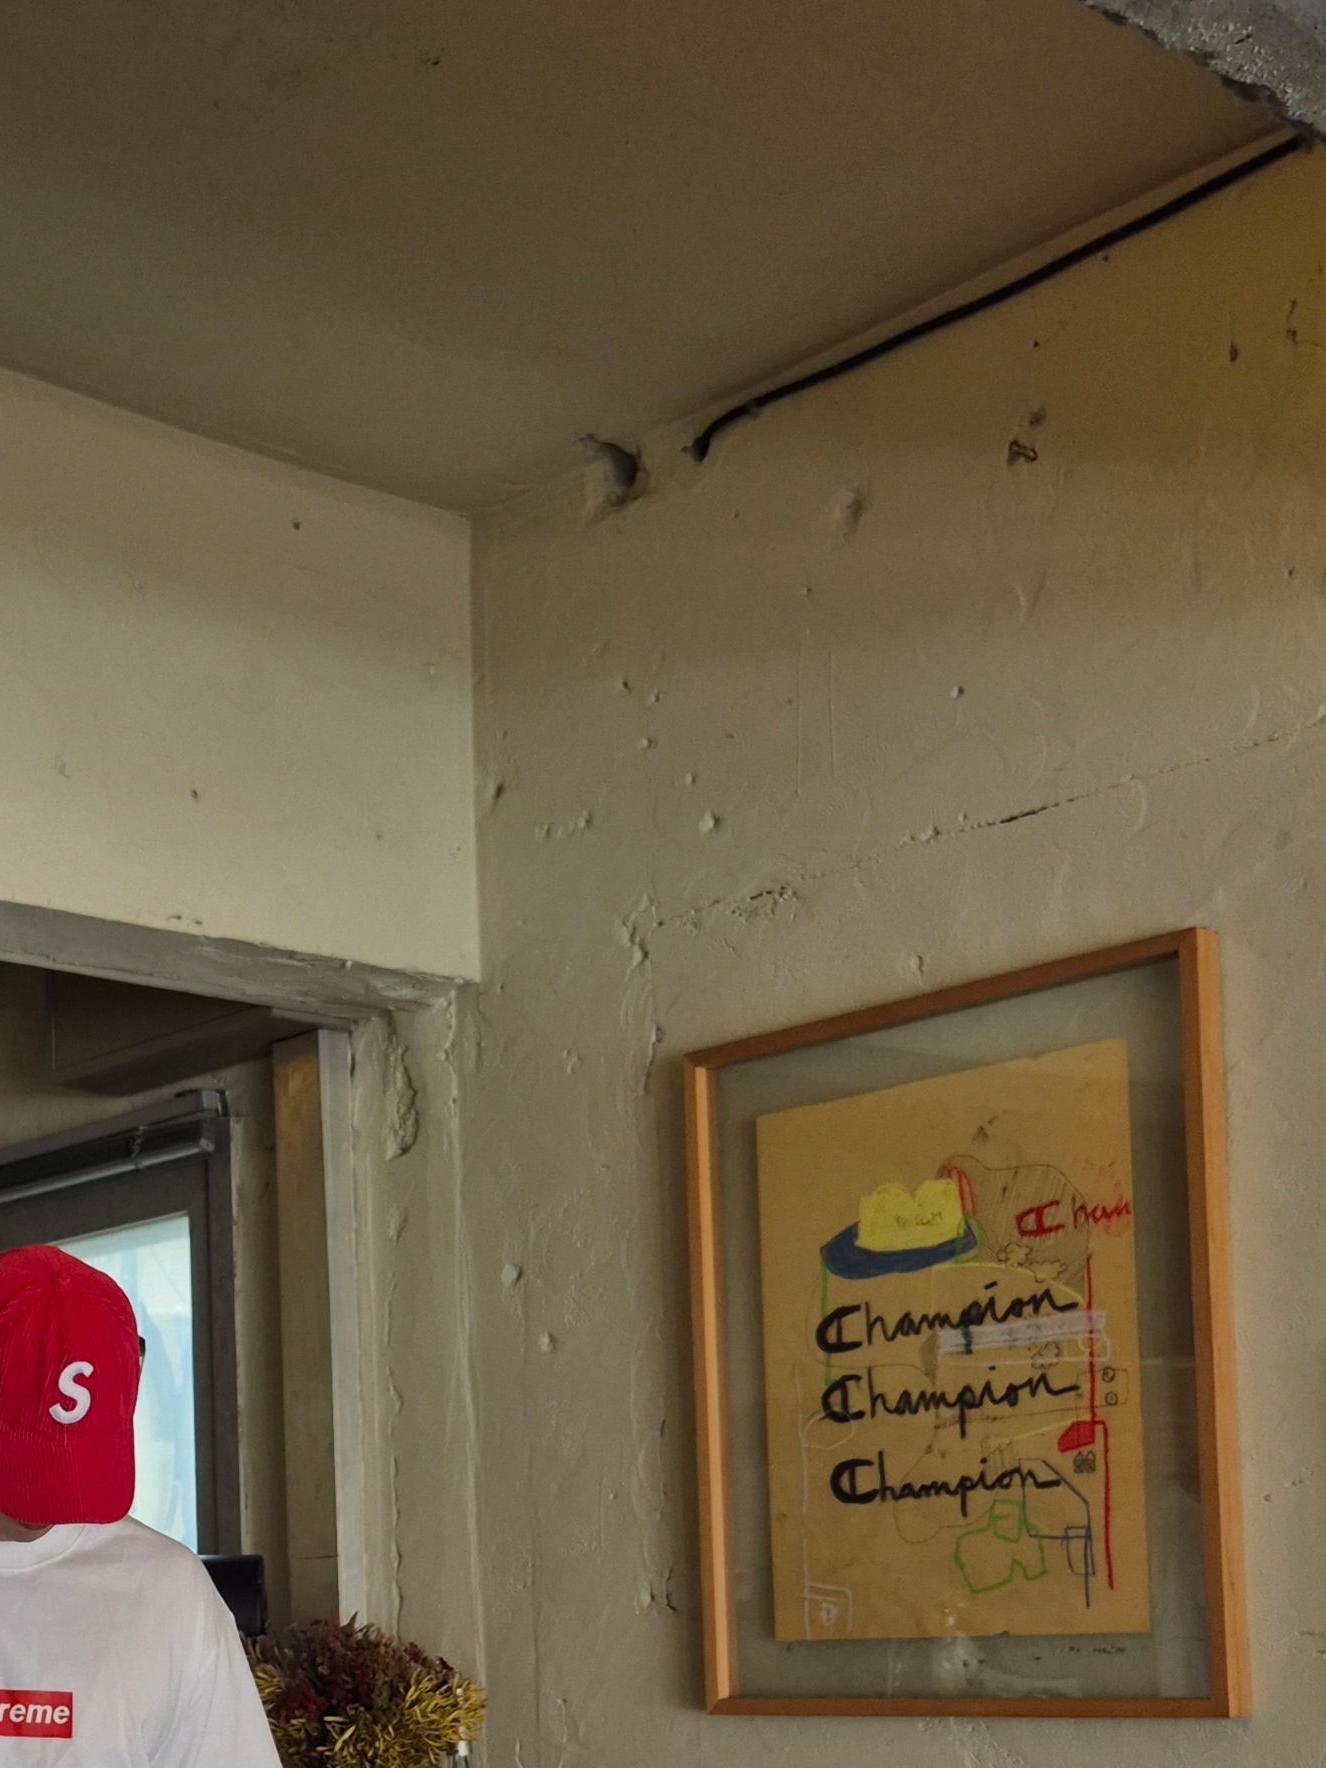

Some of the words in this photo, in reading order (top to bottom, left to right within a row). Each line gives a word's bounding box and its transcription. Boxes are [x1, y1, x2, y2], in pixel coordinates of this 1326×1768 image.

[815, 1281, 1079, 1354] Champion
[48, 1360, 95, 1425] S
[820, 1365, 1081, 1439] Champion
[829, 1450, 1062, 1518] Champion
